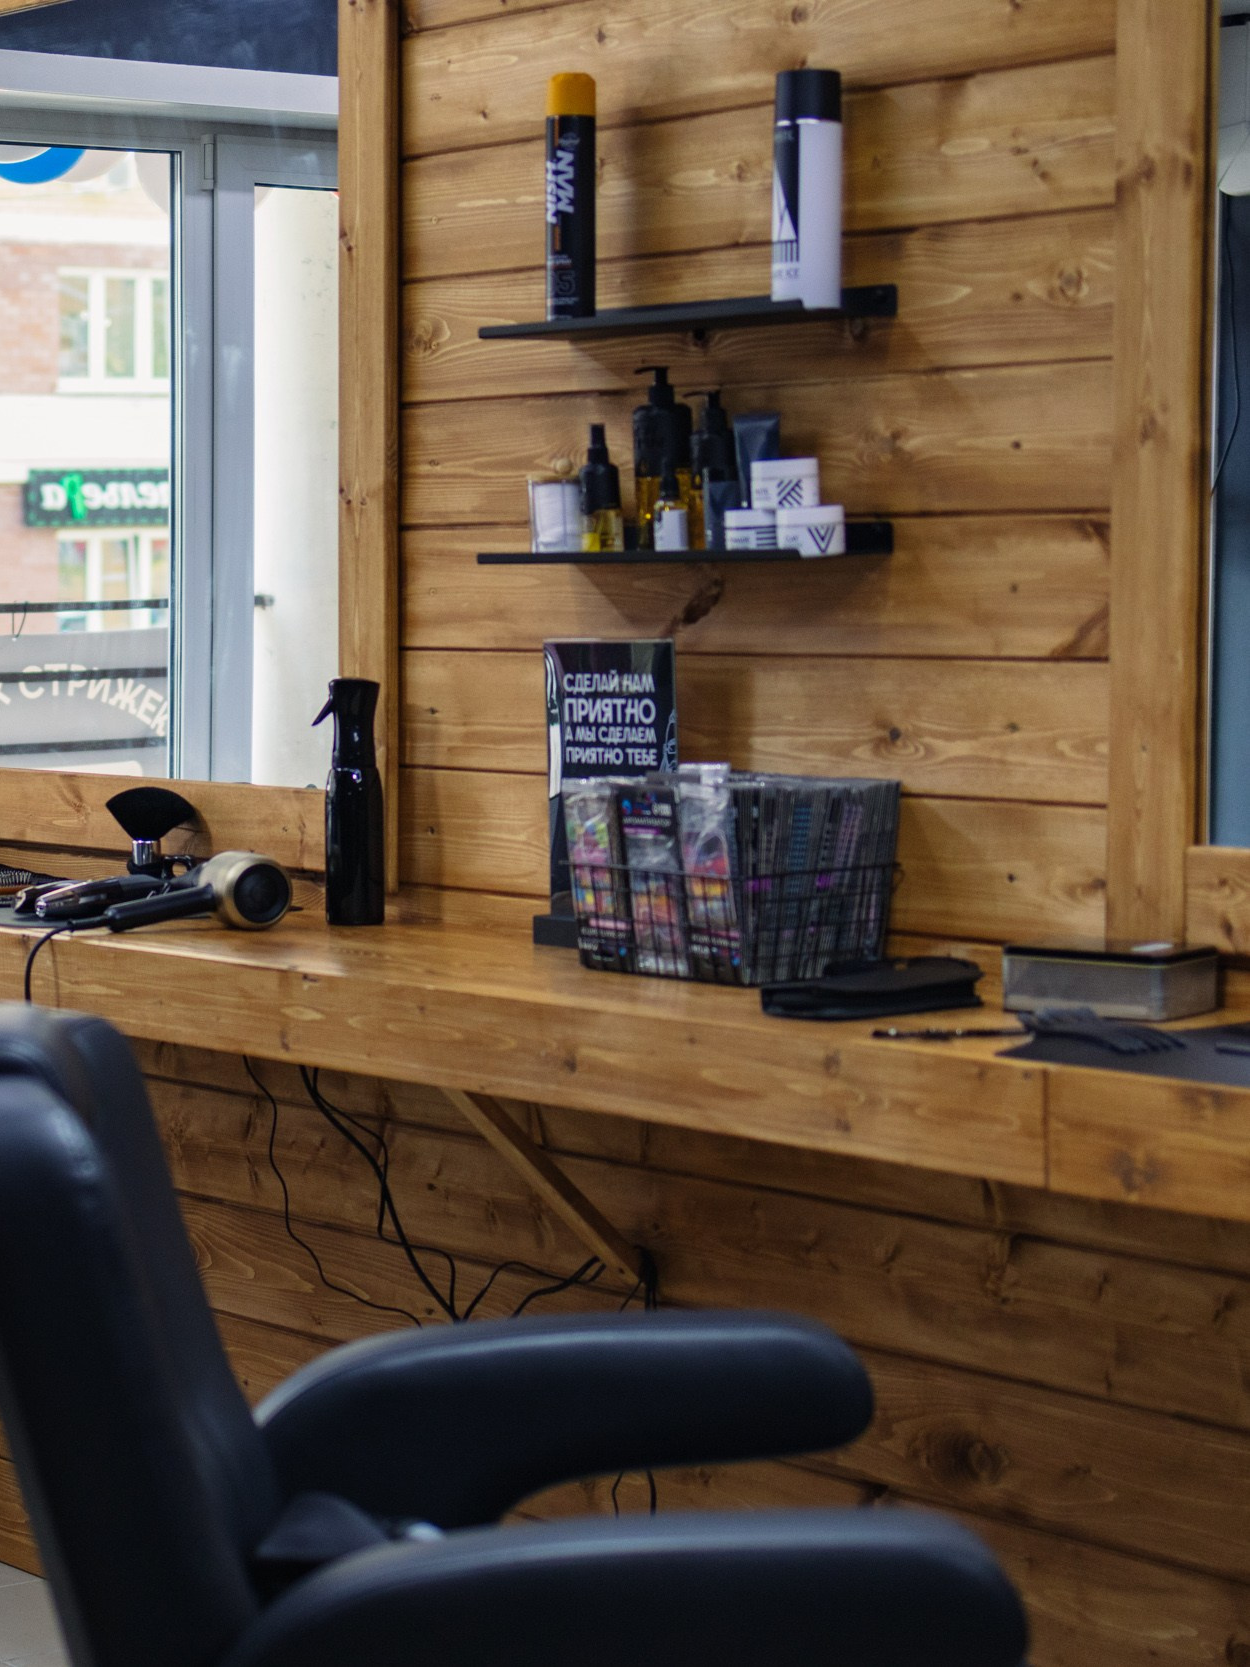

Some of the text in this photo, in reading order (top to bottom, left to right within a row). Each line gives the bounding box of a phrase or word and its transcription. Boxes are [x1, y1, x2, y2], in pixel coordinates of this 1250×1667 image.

[556, 149, 575, 214] MAN
[563, 669, 655, 695] СДЕЛАЙ НАМ
[563, 698, 656, 724] ПРИЯТНО
[564, 725, 657, 745] А МЫ СДЕЛАЕМ
[565, 746, 658, 766] ПРИЯТНО ТЕБЕ
